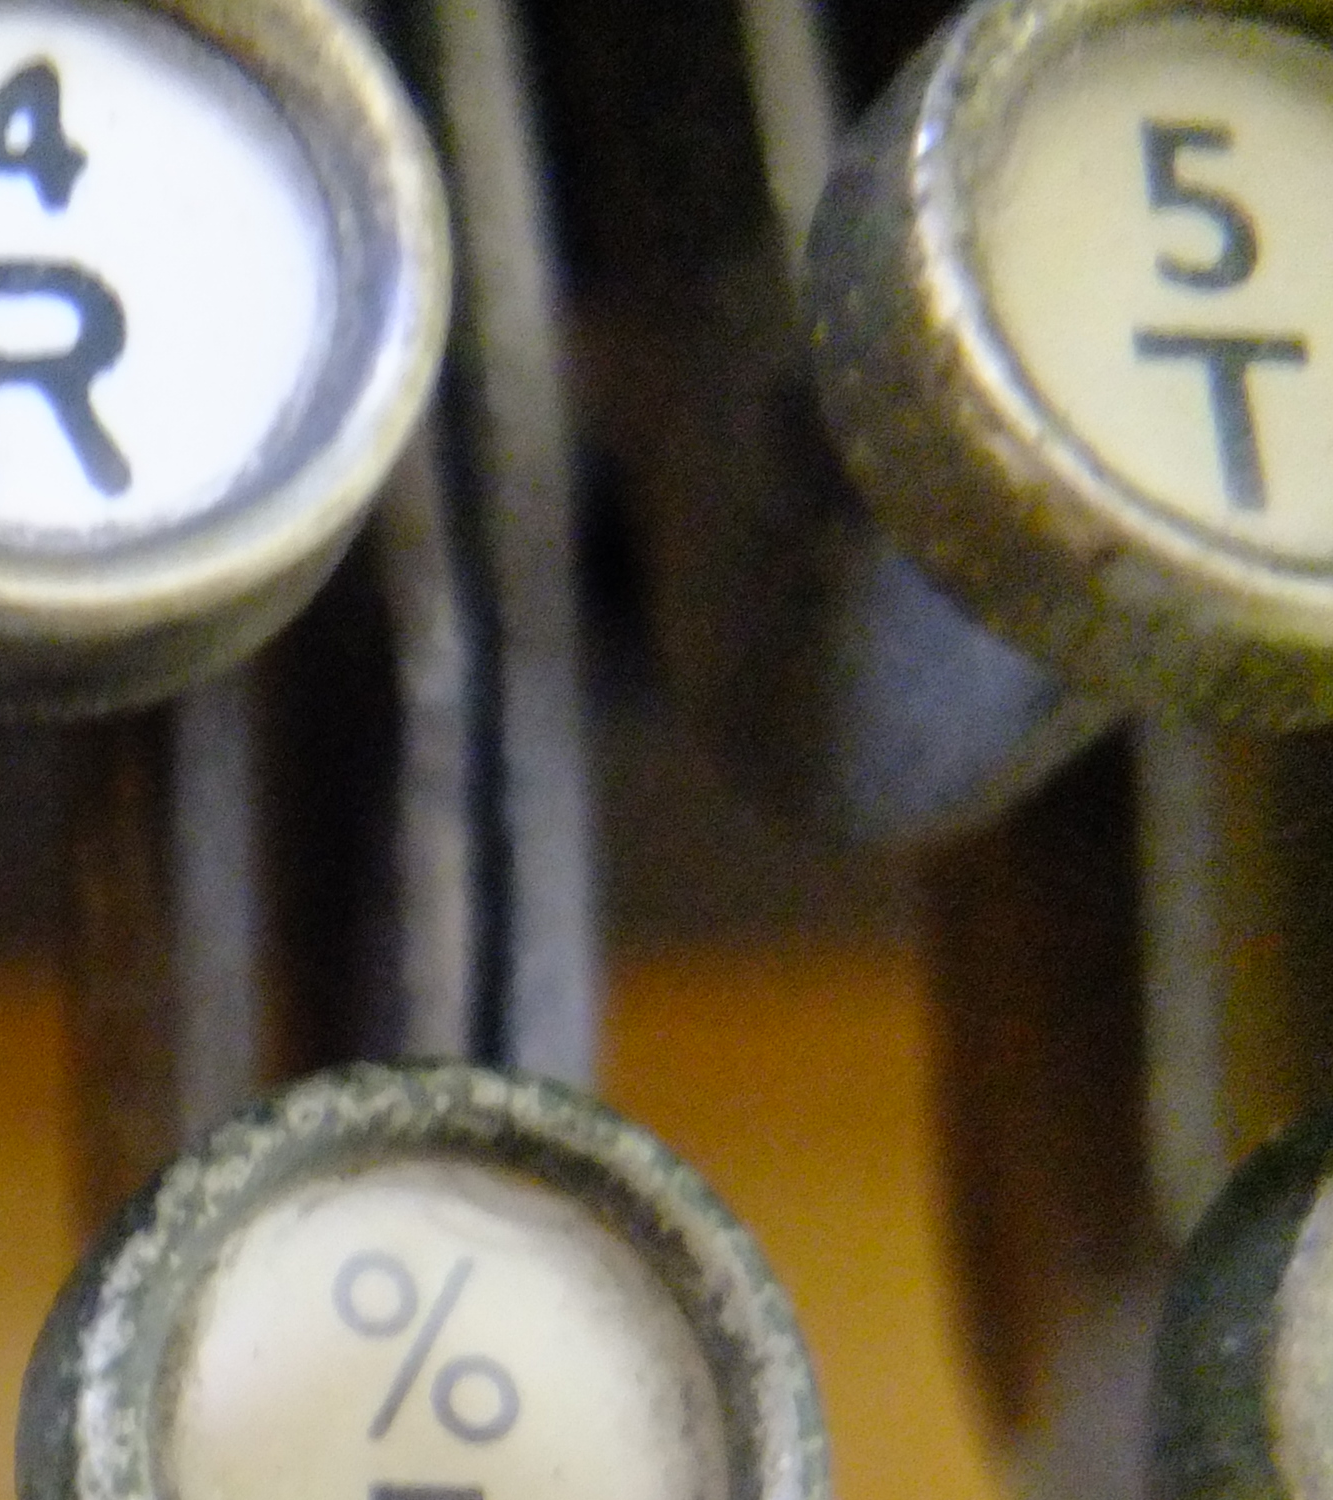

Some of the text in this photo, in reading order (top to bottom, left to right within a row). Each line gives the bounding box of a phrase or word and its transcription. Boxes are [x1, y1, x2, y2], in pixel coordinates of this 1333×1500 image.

[1140, 118, 1257, 292] 5
[1133, 328, 1309, 511] T
[333, 1250, 520, 1444] %
